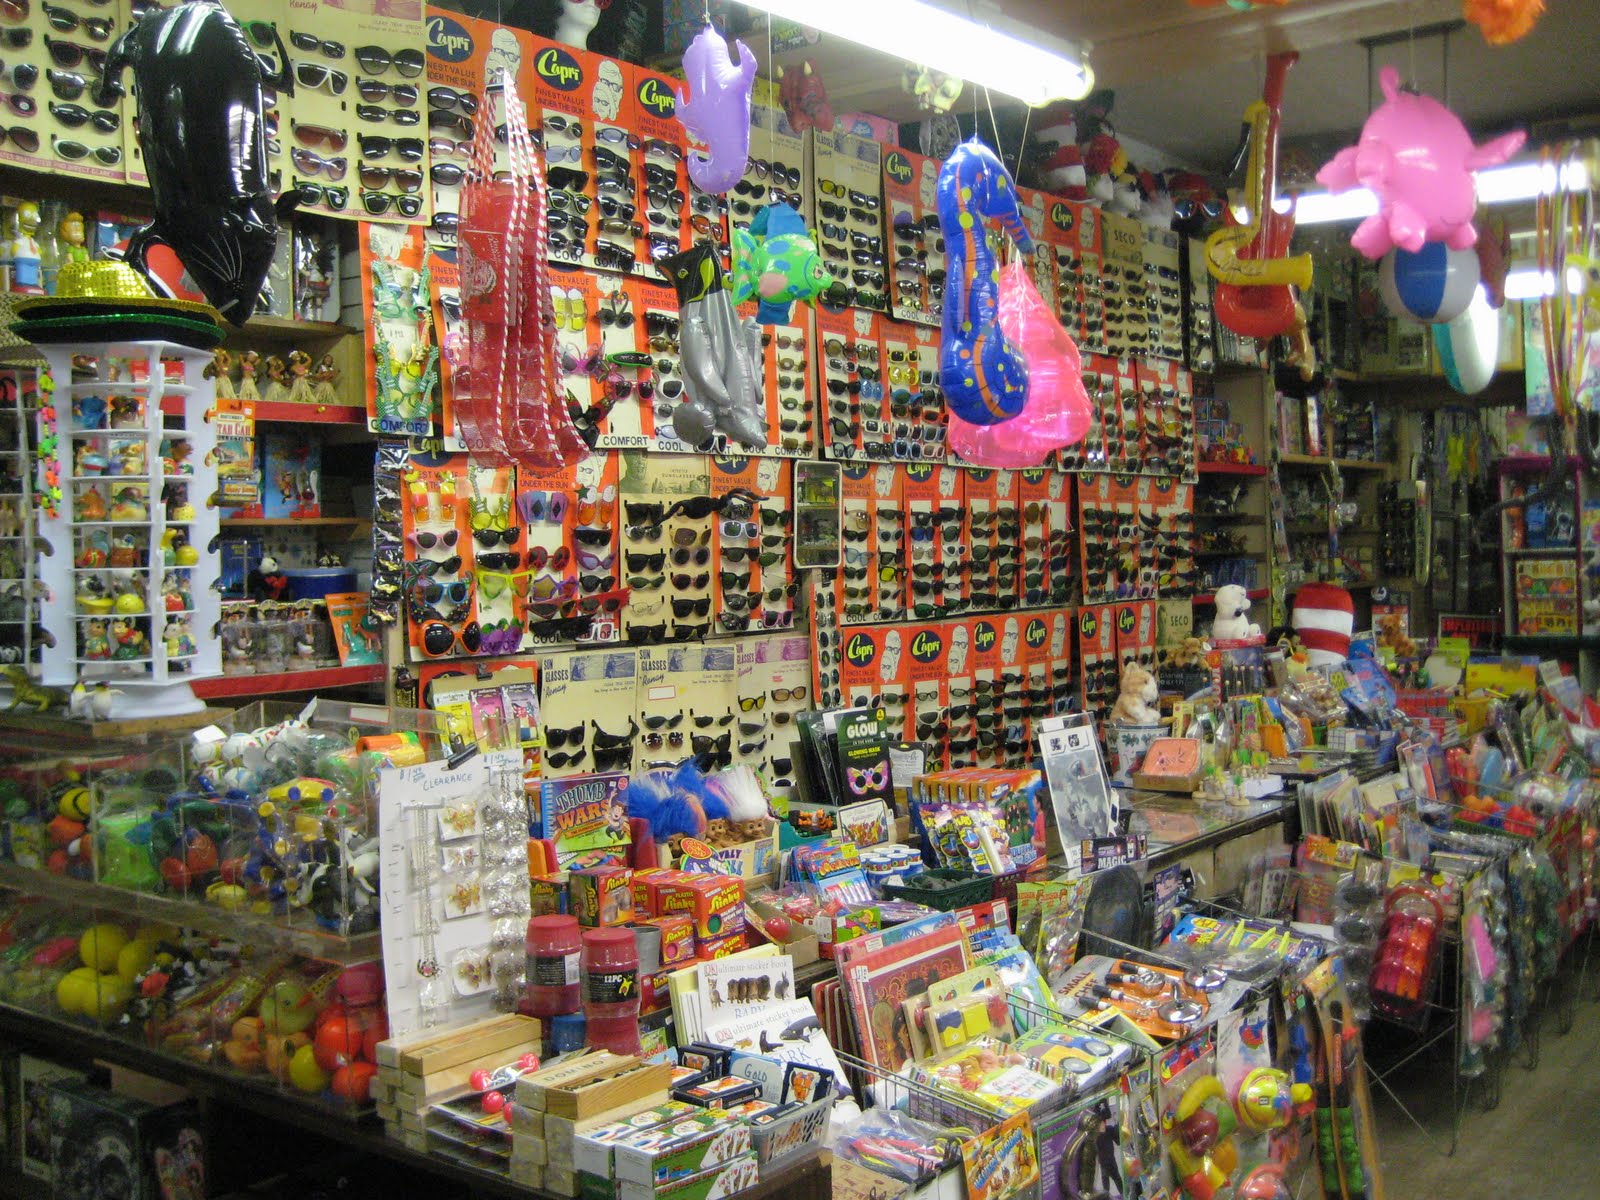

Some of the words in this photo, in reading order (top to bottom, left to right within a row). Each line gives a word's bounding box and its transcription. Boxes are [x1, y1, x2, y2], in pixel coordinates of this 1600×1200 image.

[426, 17, 471, 55] Capri
[427, 63, 450, 75] NEST
[451, 67, 476, 79] VALUE
[537, 49, 580, 85] Capri
[427, 73, 443, 83] NDER
[445, 75, 458, 85] THE
[460, 78, 476, 88] SUN
[536, 87, 560, 100] FINEST
[562, 94, 585, 106] VALUE
[639, 79, 676, 112] Capri
[535, 96, 558, 109] UNDER
[558, 102, 571, 112] THE
[571, 104, 585, 115] SUN
[886, 152, 912, 180] Capri
[1113, 229, 1136, 245] SECO
[554, 250, 584, 263] COOL
[567, 276, 589, 286] VALUE
[641, 288, 664, 298] FINEST
[642, 299, 660, 307] UNDER
[661, 300, 672, 308] THE
[901, 309, 920, 320] COOL
[603, 435, 647, 446] COMFORT
[658, 440, 684, 451] COOL
[775, 446, 812, 457] COMFORT
[520, 480, 544, 488] UNDER
[545, 480, 555, 488] THE
[556, 480, 569, 488] SUN
[846, 614, 867, 623] COOL
[1170, 616, 1189, 627] SECO
[533, 634, 561, 645] COOL
[974, 622, 995, 648] Capri
[1026, 620, 1046, 644] Capri
[848, 634, 874, 662] Capri
[912, 632, 941, 659] Capri
[639, 649, 651, 660] SUN
[737, 652, 755, 665] GLASSES
[543, 659, 554, 670] SUN
[641, 660, 667, 671] GLASSES
[545, 669, 569, 682] GLASSES
[846, 721, 878, 739] GLOW
[847, 748, 868, 757] GLOWING
[868, 746, 881, 754] MASK
[423, 773, 473, 791] CLEARANCE
[555, 781, 606, 813] THUMB
[556, 799, 610, 831] WARS
[1097, 855, 1127, 870] MAGIC
[604, 876, 630, 894] Slinky
[721, 883, 739, 896] PLASTIC
[664, 895, 696, 913] Slinky
[709, 891, 740, 915] Slinky
[665, 926, 686, 944] Slinky
[724, 935, 740, 949] PLASTIC
[704, 965, 718, 976] DK
[718, 963, 745, 974] ultimate
[745, 960, 770, 972] sticker
[771, 959, 787, 968] book
[604, 974, 623, 983] 12PC
[1058, 971, 1092, 995] SMALL
[1075, 978, 1099, 999] CHEF
[715, 1028, 734, 1043] DK
[731, 1020, 765, 1035] ultimate
[765, 1010, 789, 1025] sticker
[790, 1005, 809, 1016] book
[543, 1058, 605, 1082] DOMINO
